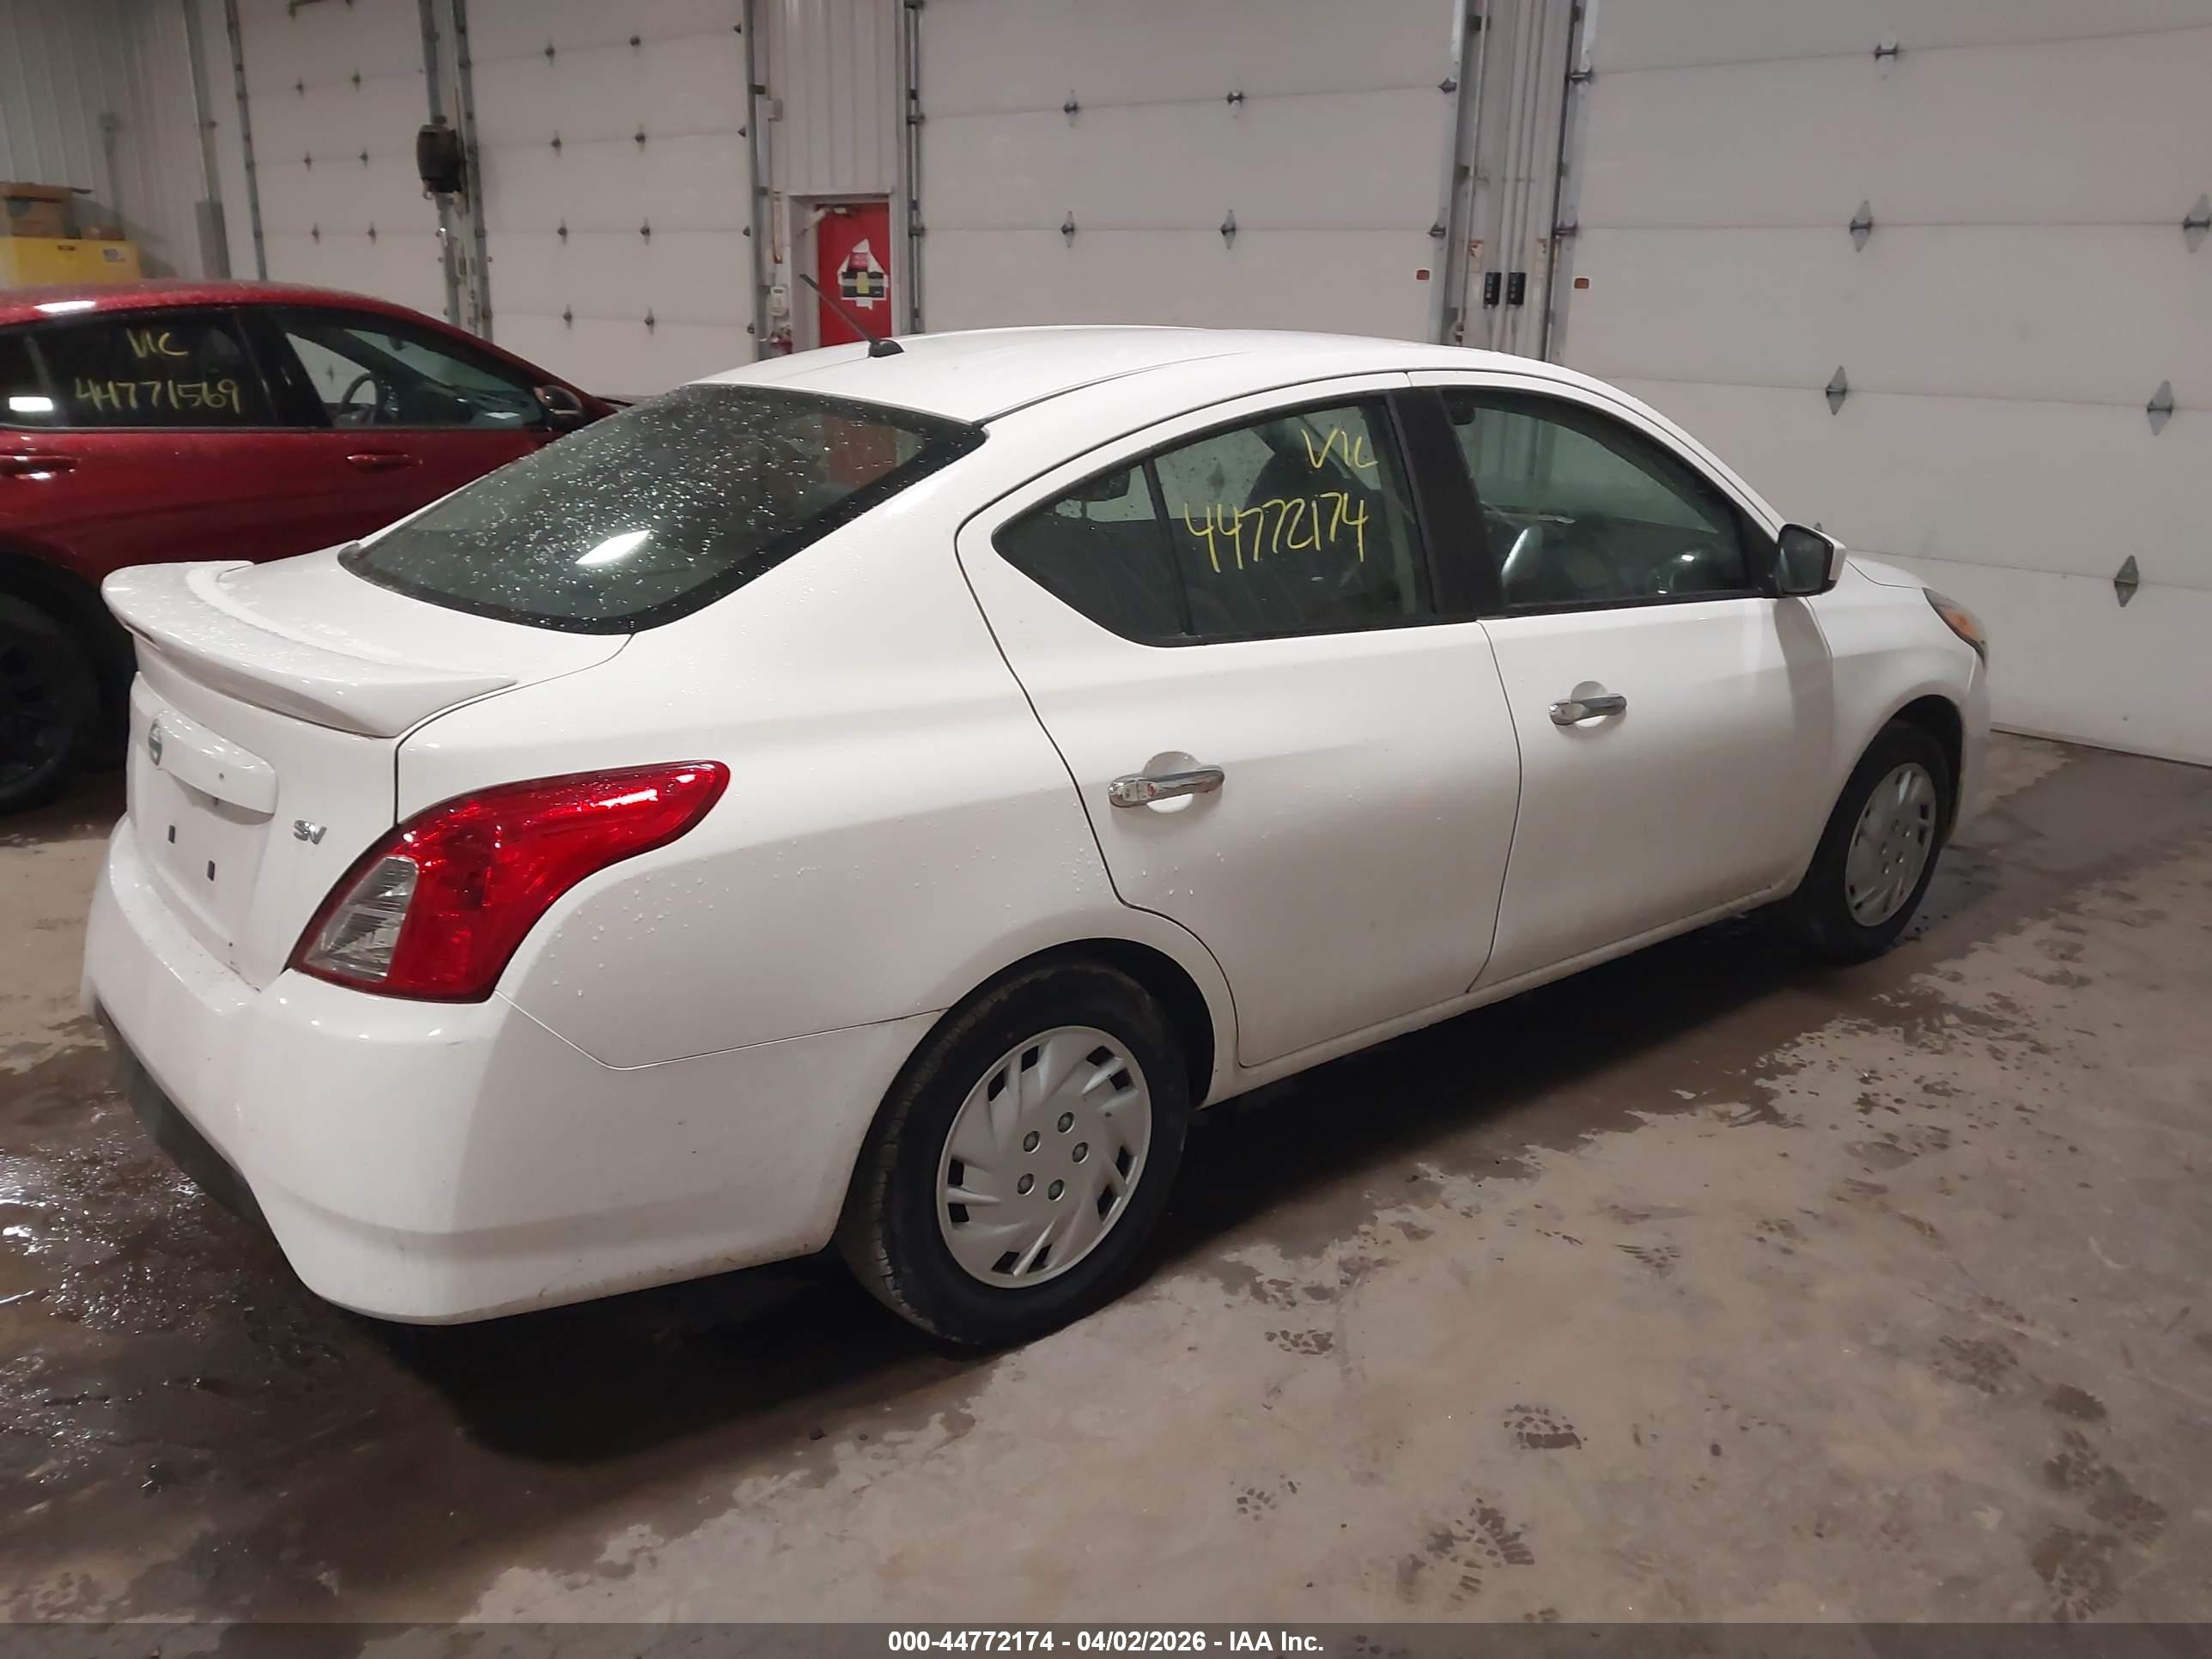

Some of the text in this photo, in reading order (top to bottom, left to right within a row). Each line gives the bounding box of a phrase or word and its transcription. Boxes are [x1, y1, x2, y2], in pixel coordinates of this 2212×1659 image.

[75, 378, 241, 415] 44771569
[1184, 491, 1370, 574] 44772174
[294, 819, 327, 846] SV
